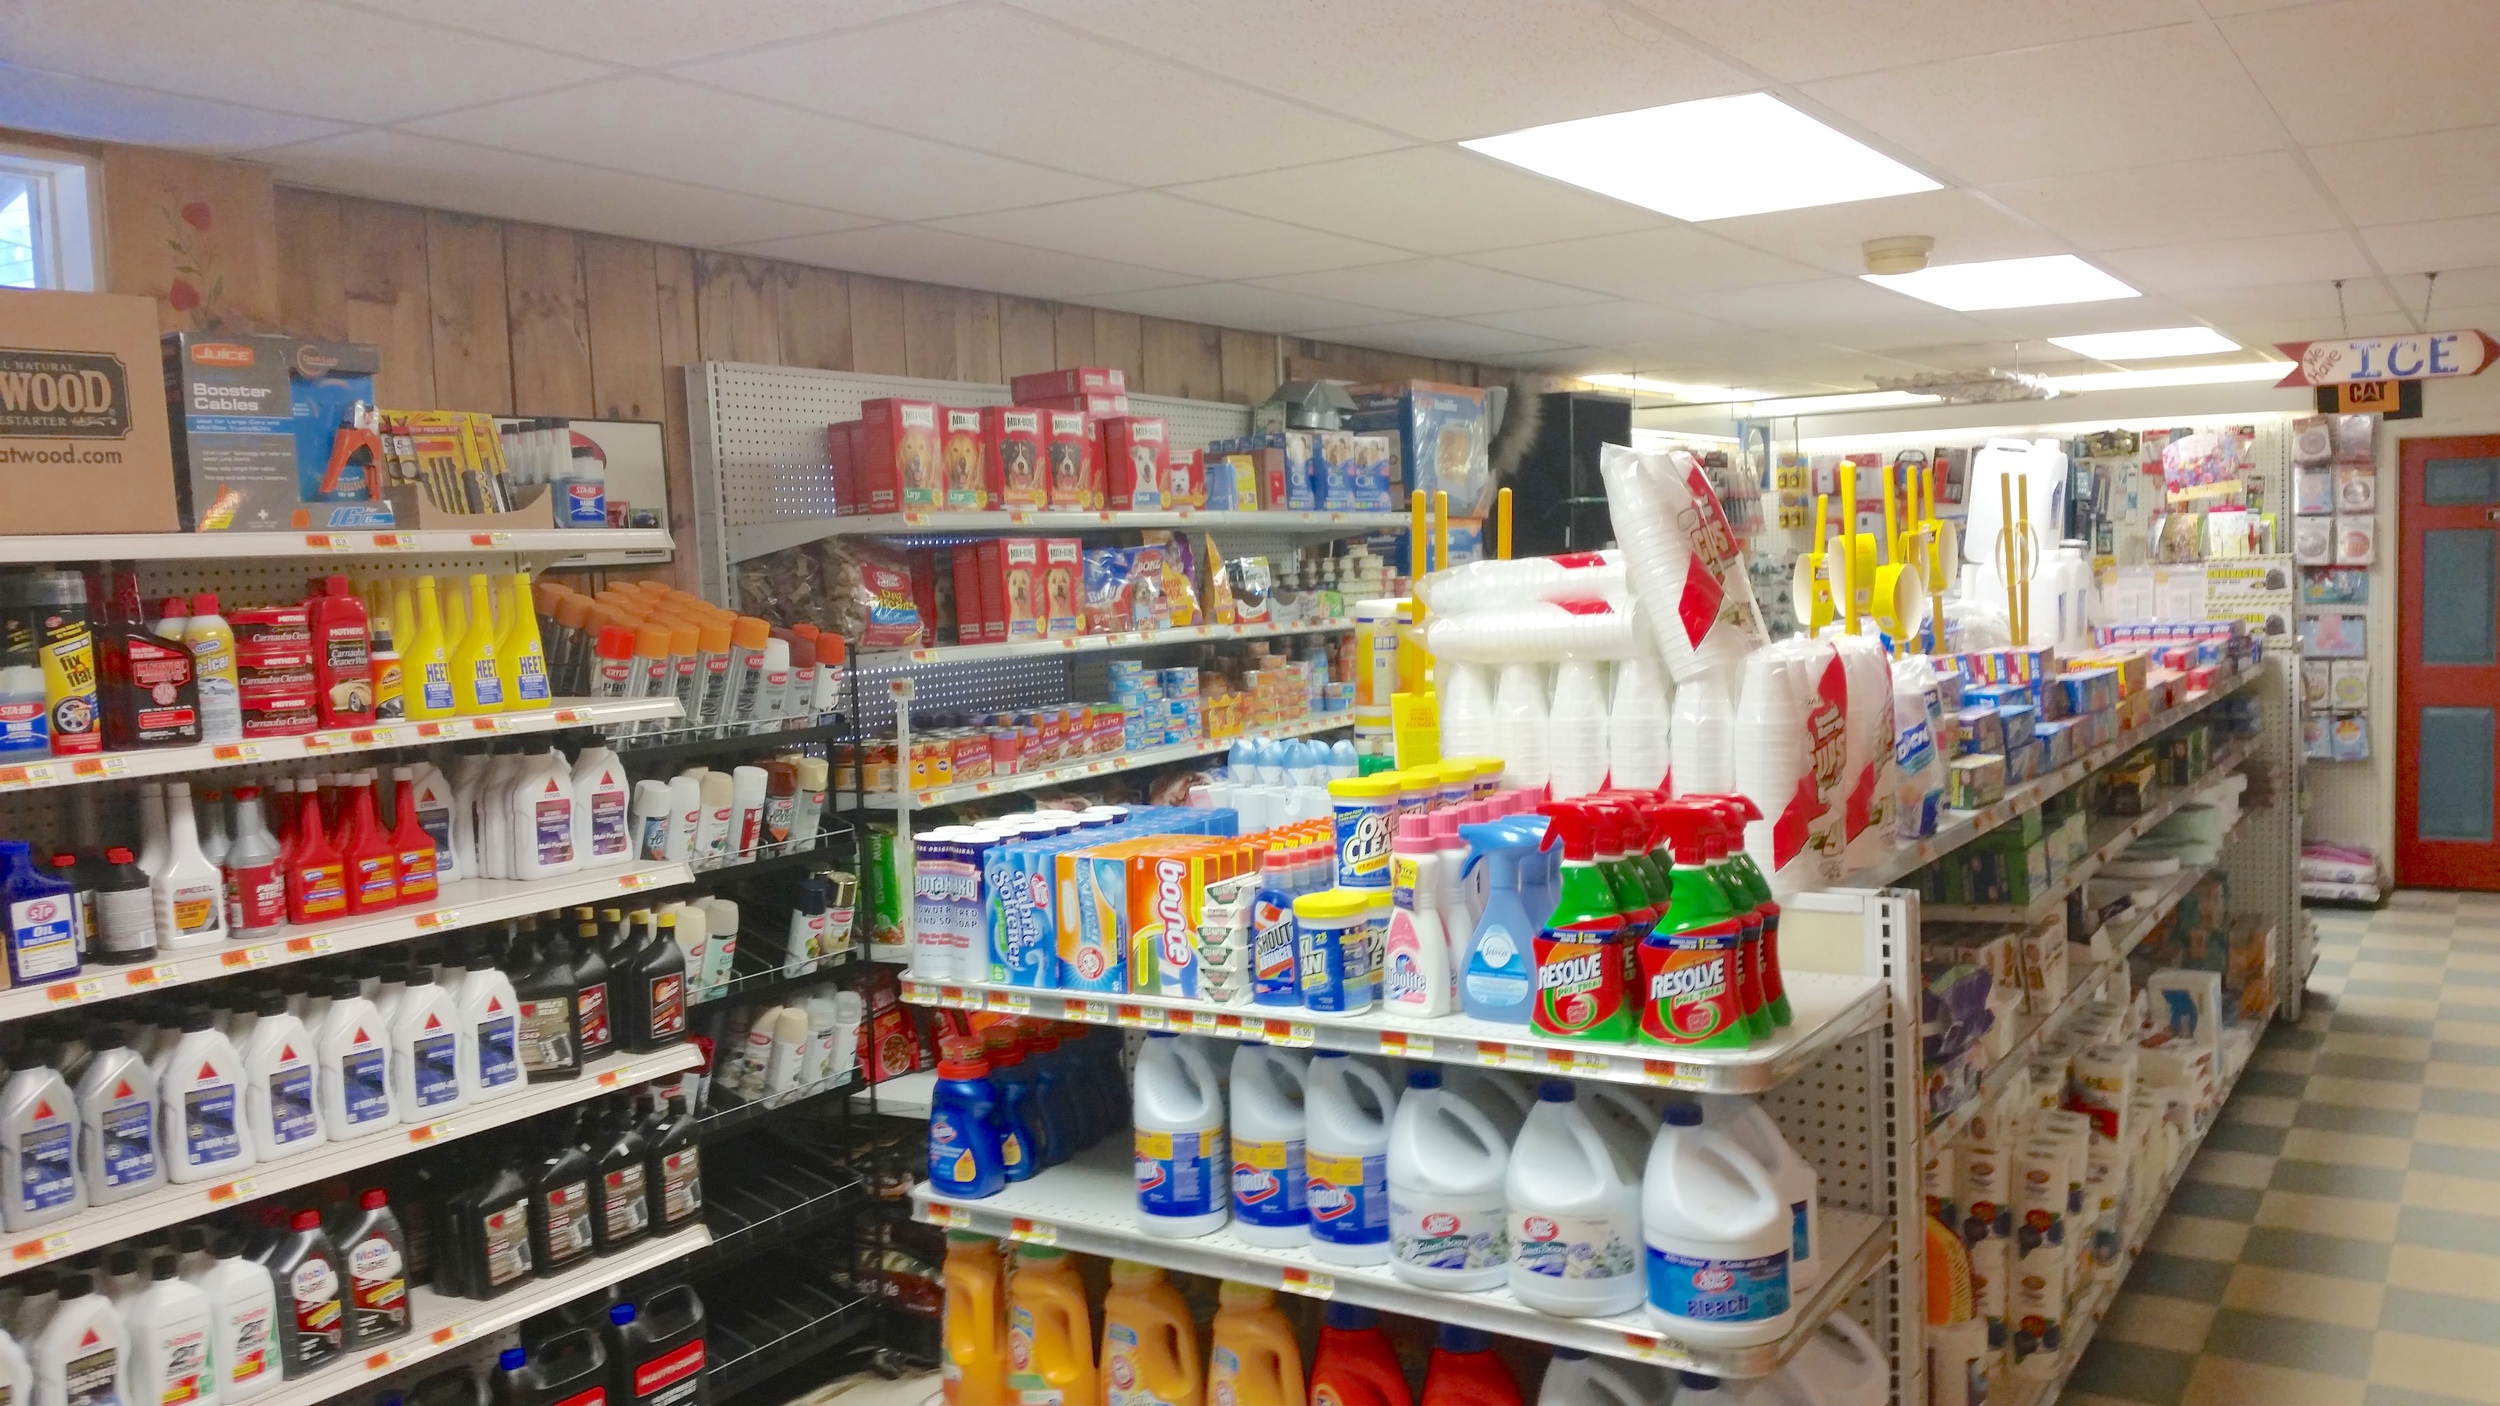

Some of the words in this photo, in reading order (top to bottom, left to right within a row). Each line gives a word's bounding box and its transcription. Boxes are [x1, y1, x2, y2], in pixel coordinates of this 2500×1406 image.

[2303, 348, 2325, 367] We
[2308, 349, 2342, 382] Have
[2350, 335, 2459, 379] ICE
[15, 362, 74, 373] NATURAL
[193, 383, 272, 399] Booster
[2349, 381, 2388, 403] CAT
[195, 397, 260, 412] Cables
[1006, 415, 1036, 430] MILK-BONE
[330, 627, 364, 637] MOTHERS
[60, 655, 82, 672] fix
[137, 661, 187, 676] MARVEL
[196, 654, 230, 675] e-Icer
[425, 663, 449, 682] HEET
[475, 659, 498, 679] HEET
[519, 656, 543, 675] HEET
[1344, 842, 1394, 866] CLEA
[30, 902, 54, 921] STP
[991, 869, 1020, 968] Softener
[1012, 870, 1039, 948] Fabric
[1158, 860, 1190, 966] bounce
[33, 924, 55, 938] OIL
[1257, 922, 1293, 956] SHOUT
[1538, 952, 1602, 991] RESOLVE
[1651, 958, 1725, 1000] RESOLVE
[355, 1244, 389, 1263] Mobil
[1687, 1295, 1748, 1318] Bleach
